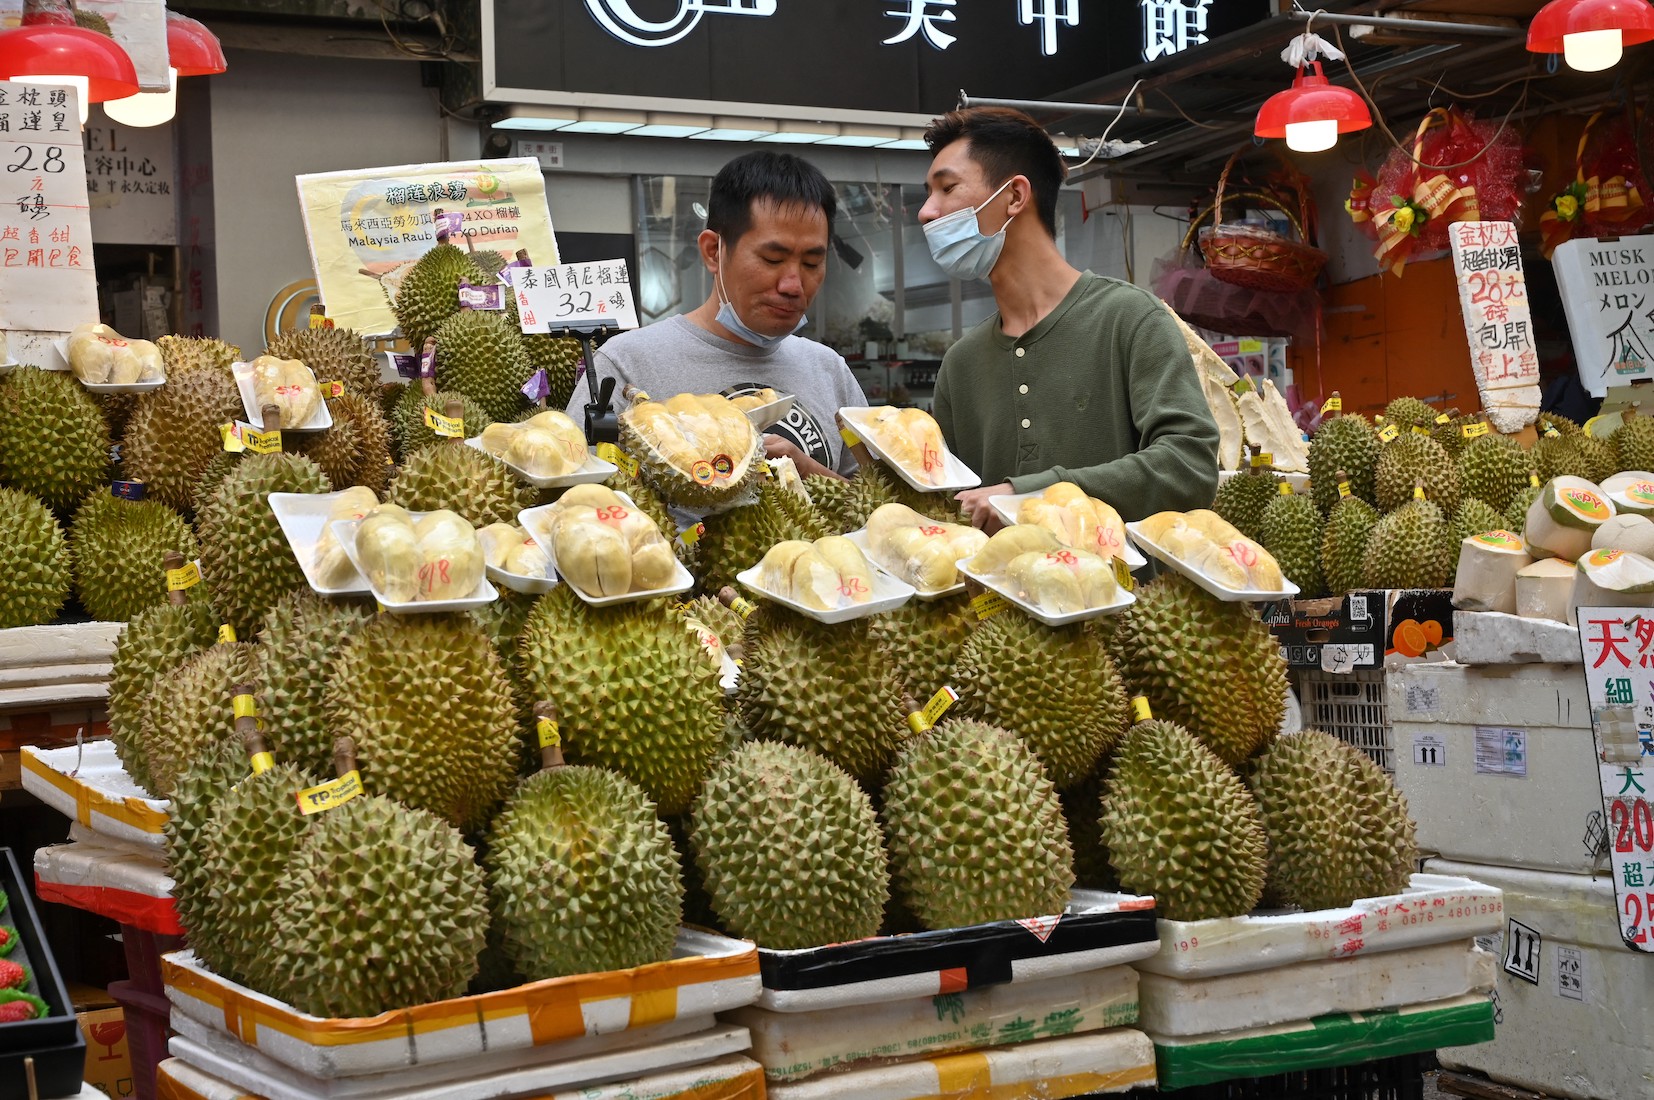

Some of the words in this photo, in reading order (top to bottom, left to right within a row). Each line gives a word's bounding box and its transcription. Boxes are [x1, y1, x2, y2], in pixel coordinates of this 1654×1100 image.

[7, 145, 66, 174] 28
[86, 154, 156, 177] 容中心
[475, 208, 493, 221] XO
[348, 235, 401, 248] Malaysia
[402, 232, 433, 244] Raub
[480, 224, 519, 236] Durian
[1589, 249, 1646, 267] MUSK
[1468, 269, 1503, 304] 28
[1505, 275, 1523, 300] 元
[555, 291, 595, 317] 32
[1599, 292, 1646, 312] メロン
[1476, 321, 1532, 351] 包開
[430, 414, 442, 427] TP
[247, 433, 259, 447] TP
[923, 442, 943, 472] 68
[1571, 489, 1602, 509] KPY
[596, 505, 628, 521] 68
[1096, 526, 1119, 547] 88
[1046, 550, 1078, 566] 58
[1295, 618, 1312, 629] Fresh
[1605, 678, 1634, 704] 細
[308, 790, 330, 806] TP
[330, 777, 355, 793] Tropical
[1615, 767, 1646, 795] 大
[331, 783, 360, 801] Premium
